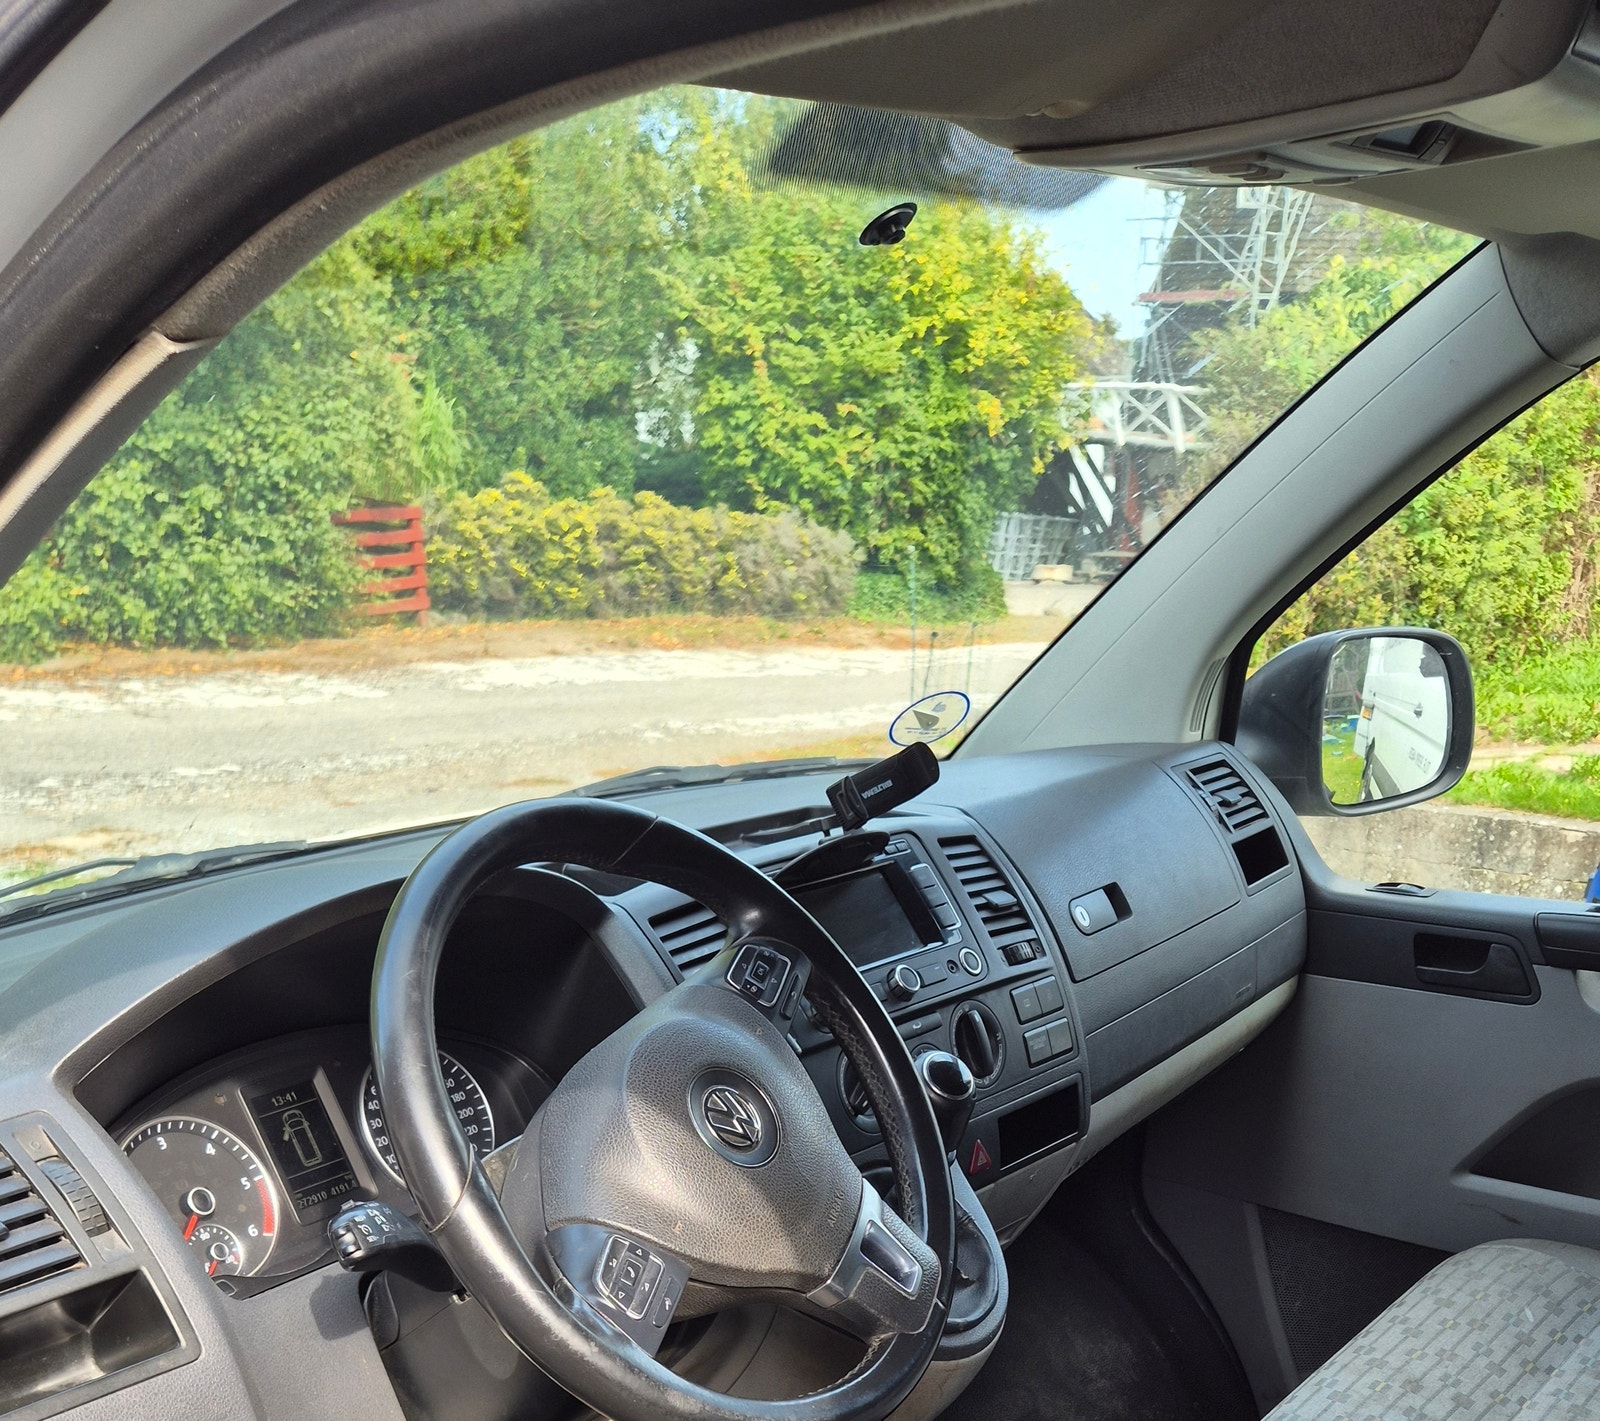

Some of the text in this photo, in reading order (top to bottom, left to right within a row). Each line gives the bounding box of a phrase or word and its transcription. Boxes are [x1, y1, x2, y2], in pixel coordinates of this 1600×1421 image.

[272, 1091, 298, 1106] 13:41
[450, 1091, 466, 1103] 180
[368, 1100, 380, 1110] 40
[457, 1107, 474, 1119] 200
[370, 1118, 382, 1129] 30
[156, 1137, 167, 1150] 3
[375, 1136, 388, 1147] 20
[205, 1143, 216, 1155] 4
[241, 1177, 250, 1190] 5
[828, 1191, 845, 1228] AIRBAG
[248, 1224, 258, 1237] 6
